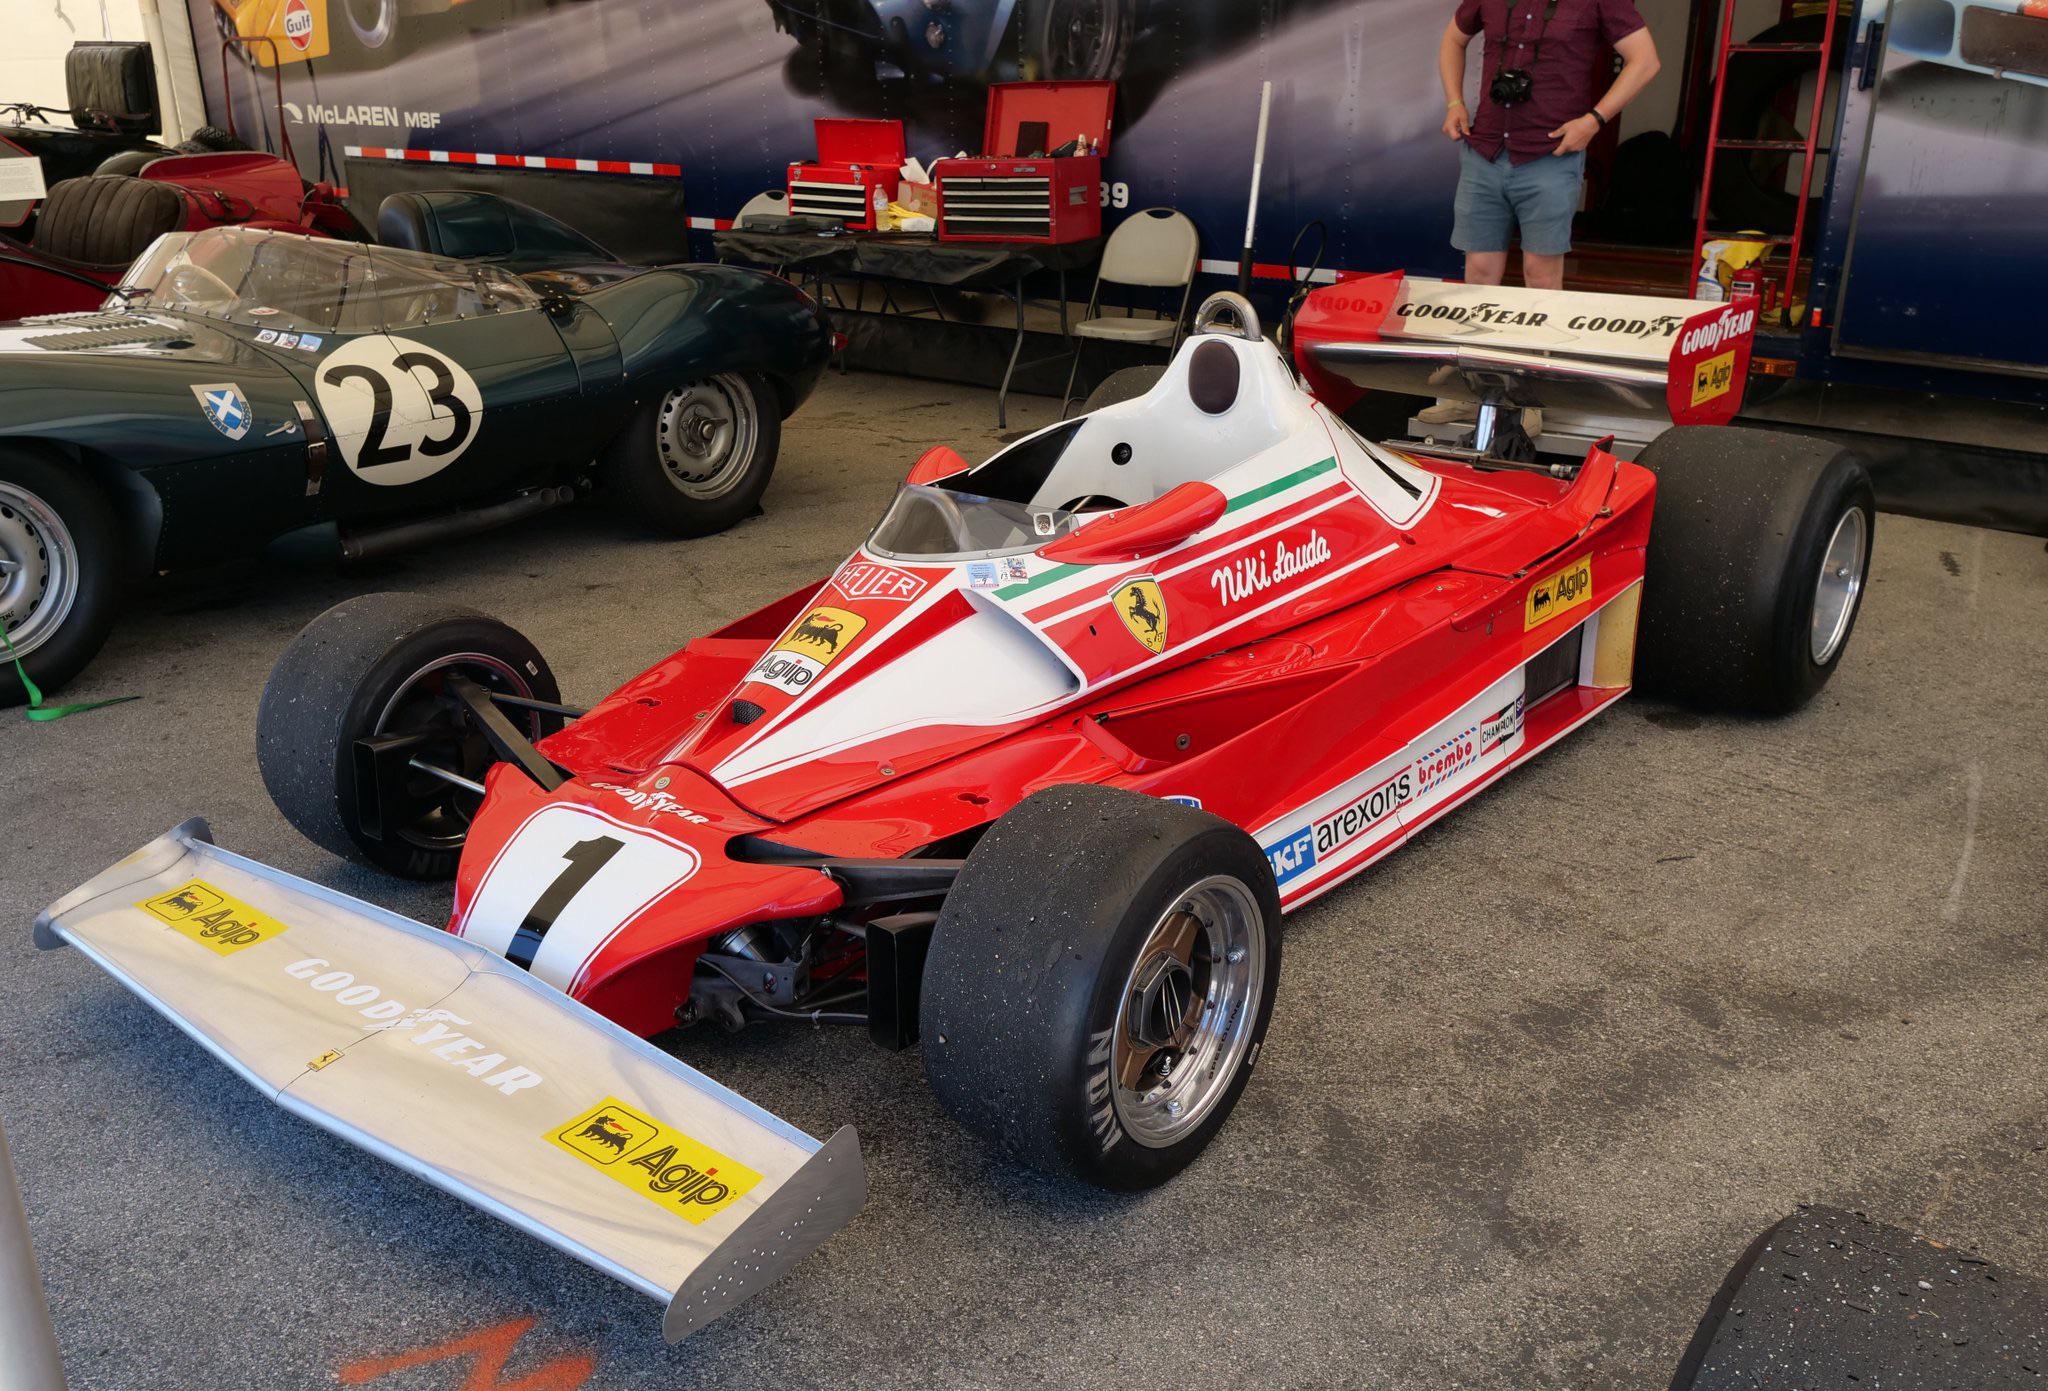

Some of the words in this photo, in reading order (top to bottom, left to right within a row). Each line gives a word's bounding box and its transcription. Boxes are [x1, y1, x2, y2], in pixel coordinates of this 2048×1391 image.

[286, 14, 310, 33] Gulf
[306, 104, 399, 127] McLAREN
[404, 111, 441, 129] M8F
[1397, 303, 1548, 327] GOODYEAR
[1567, 315, 1685, 339] GOODY
[1682, 308, 1754, 356] GOODYEAR
[1710, 361, 1732, 390] Agip
[323, 352, 472, 470] 23
[1273, 528, 1331, 583] Lauda
[838, 565, 917, 596] HEUER
[1555, 566, 1589, 602] Agip
[752, 654, 813, 686] Agip
[1482, 714, 1514, 743] CHAMPION
[1418, 741, 1473, 784] brembo
[591, 782, 710, 824] GOODYEAR
[1317, 773, 1411, 853] arexons
[504, 835, 627, 972] 1
[192, 908, 260, 946] Agip
[284, 958, 544, 1097] GOODYEAR
[627, 1144, 729, 1207] Agip
